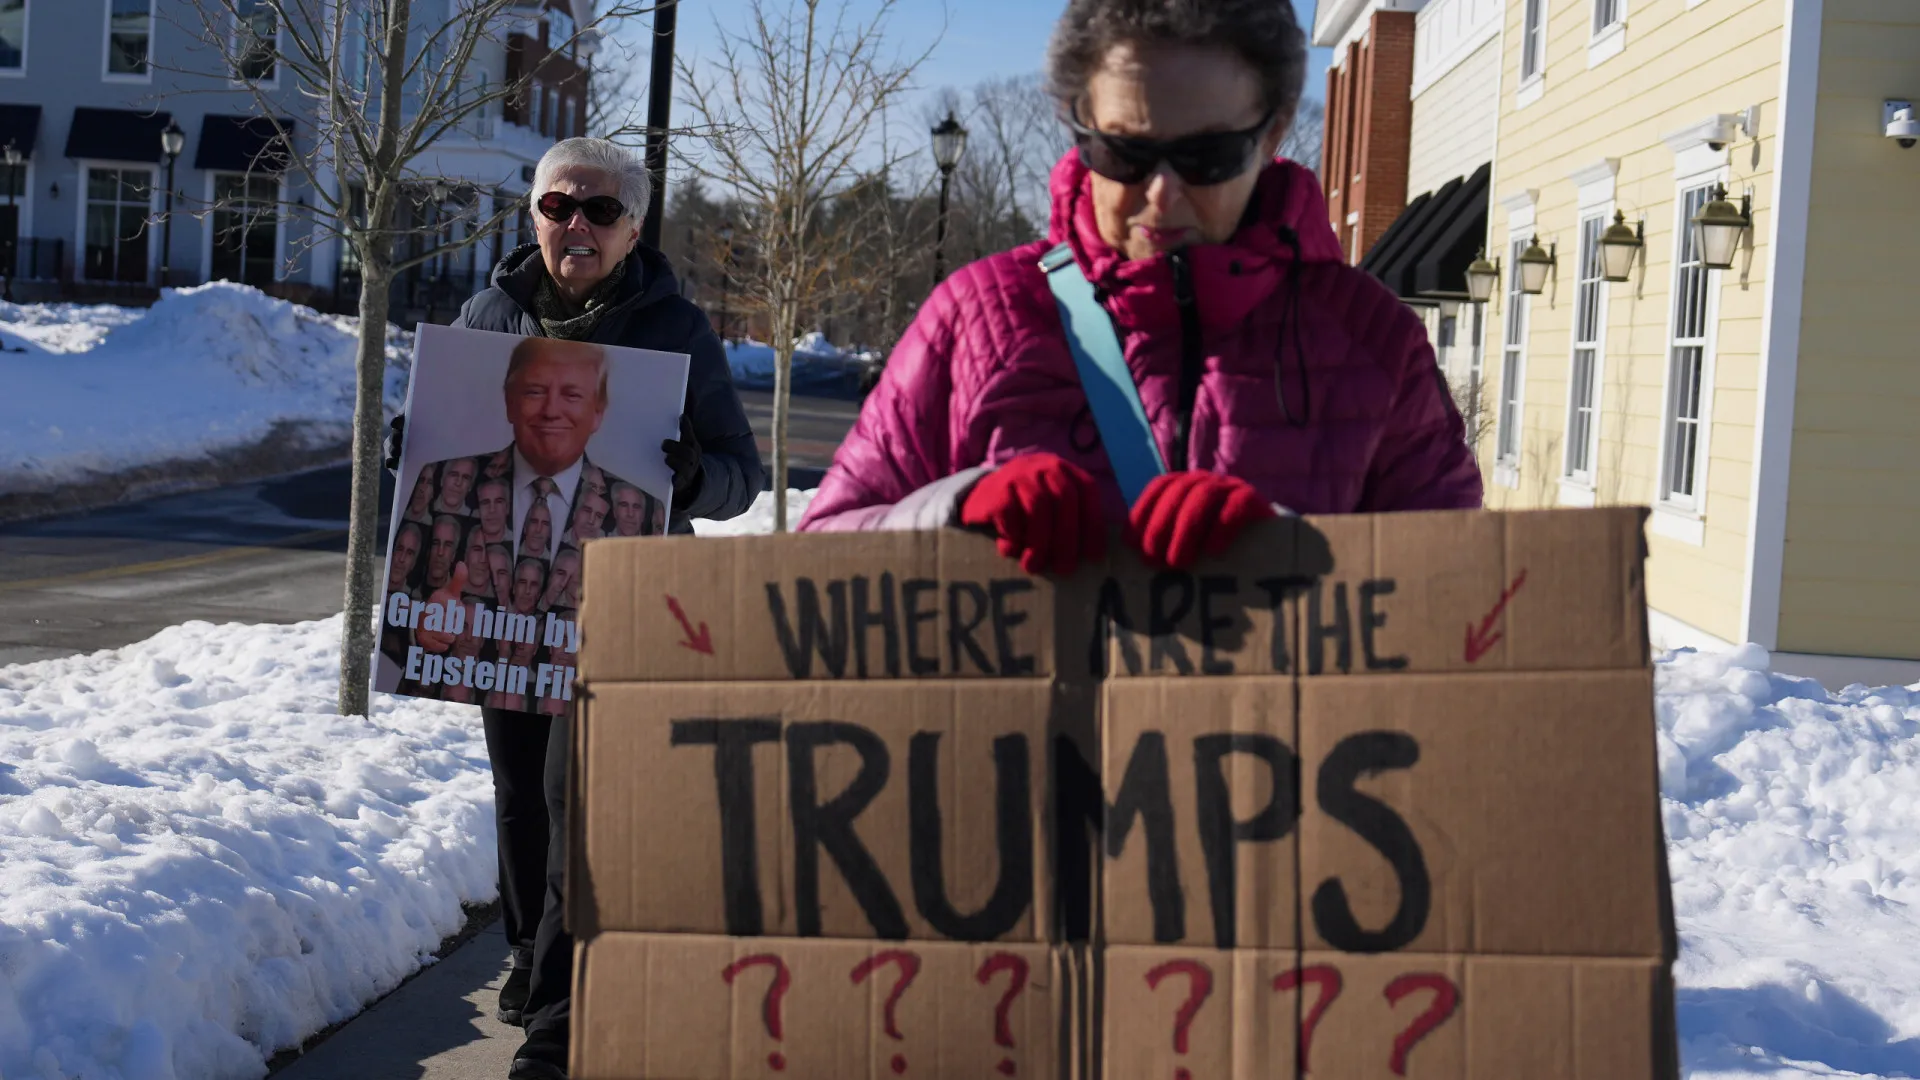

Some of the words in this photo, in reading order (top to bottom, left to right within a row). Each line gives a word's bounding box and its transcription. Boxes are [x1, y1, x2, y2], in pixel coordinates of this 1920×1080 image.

[387, 592, 466, 636] Grab
[472, 602, 537, 645] him
[543, 611, 577, 654] by
[765, 570, 1038, 680] WHERE
[1088, 570, 1240, 677] ARE
[1255, 574, 1408, 676] THE
[404, 645, 529, 696] Epstein
[671, 716, 1431, 954] TRUMPS
